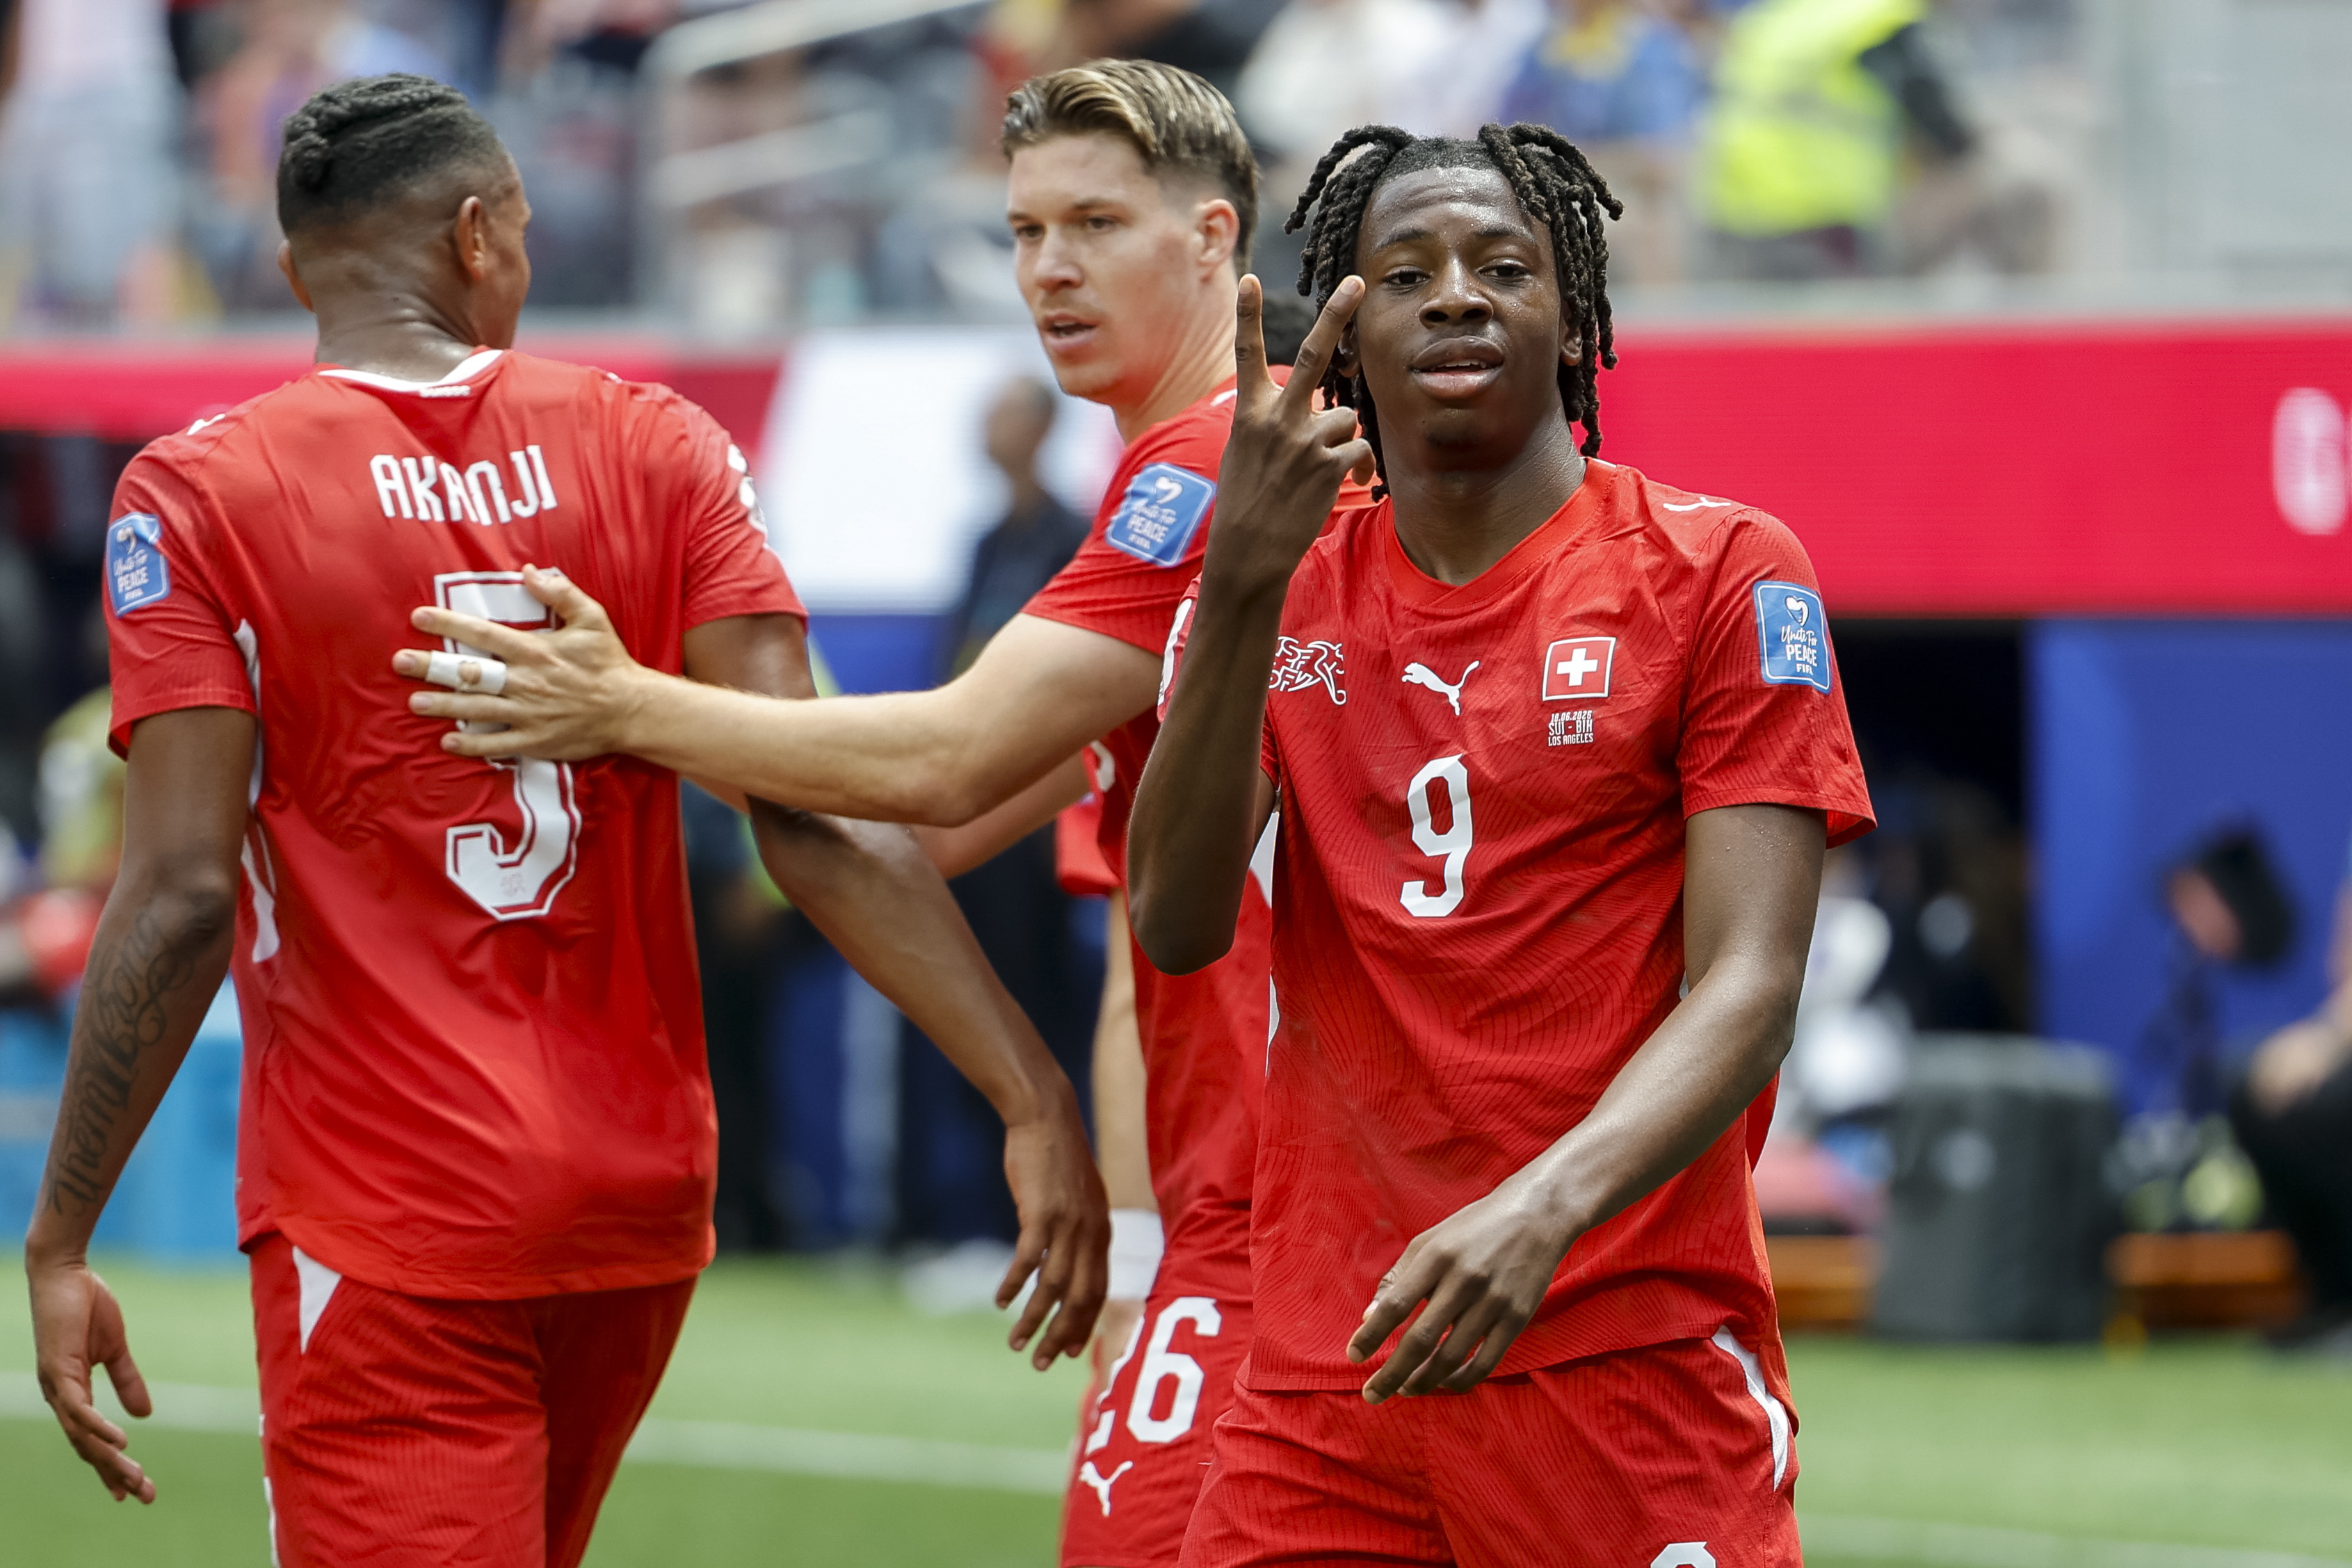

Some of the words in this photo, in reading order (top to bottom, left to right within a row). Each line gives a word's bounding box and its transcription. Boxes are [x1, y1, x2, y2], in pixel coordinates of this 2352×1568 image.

[369, 445, 557, 526] AKANJI
[117, 565, 150, 594] PEACE
[1785, 644, 1818, 668] PEACE
[1796, 663, 1814, 676] FIFA
[1548, 721, 1565, 736] SUI
[1576, 719, 1593, 734] BIH
[1548, 736, 1562, 747] LOS
[1563, 733, 1594, 745] ANGELES
[1399, 753, 1473, 917] 9
